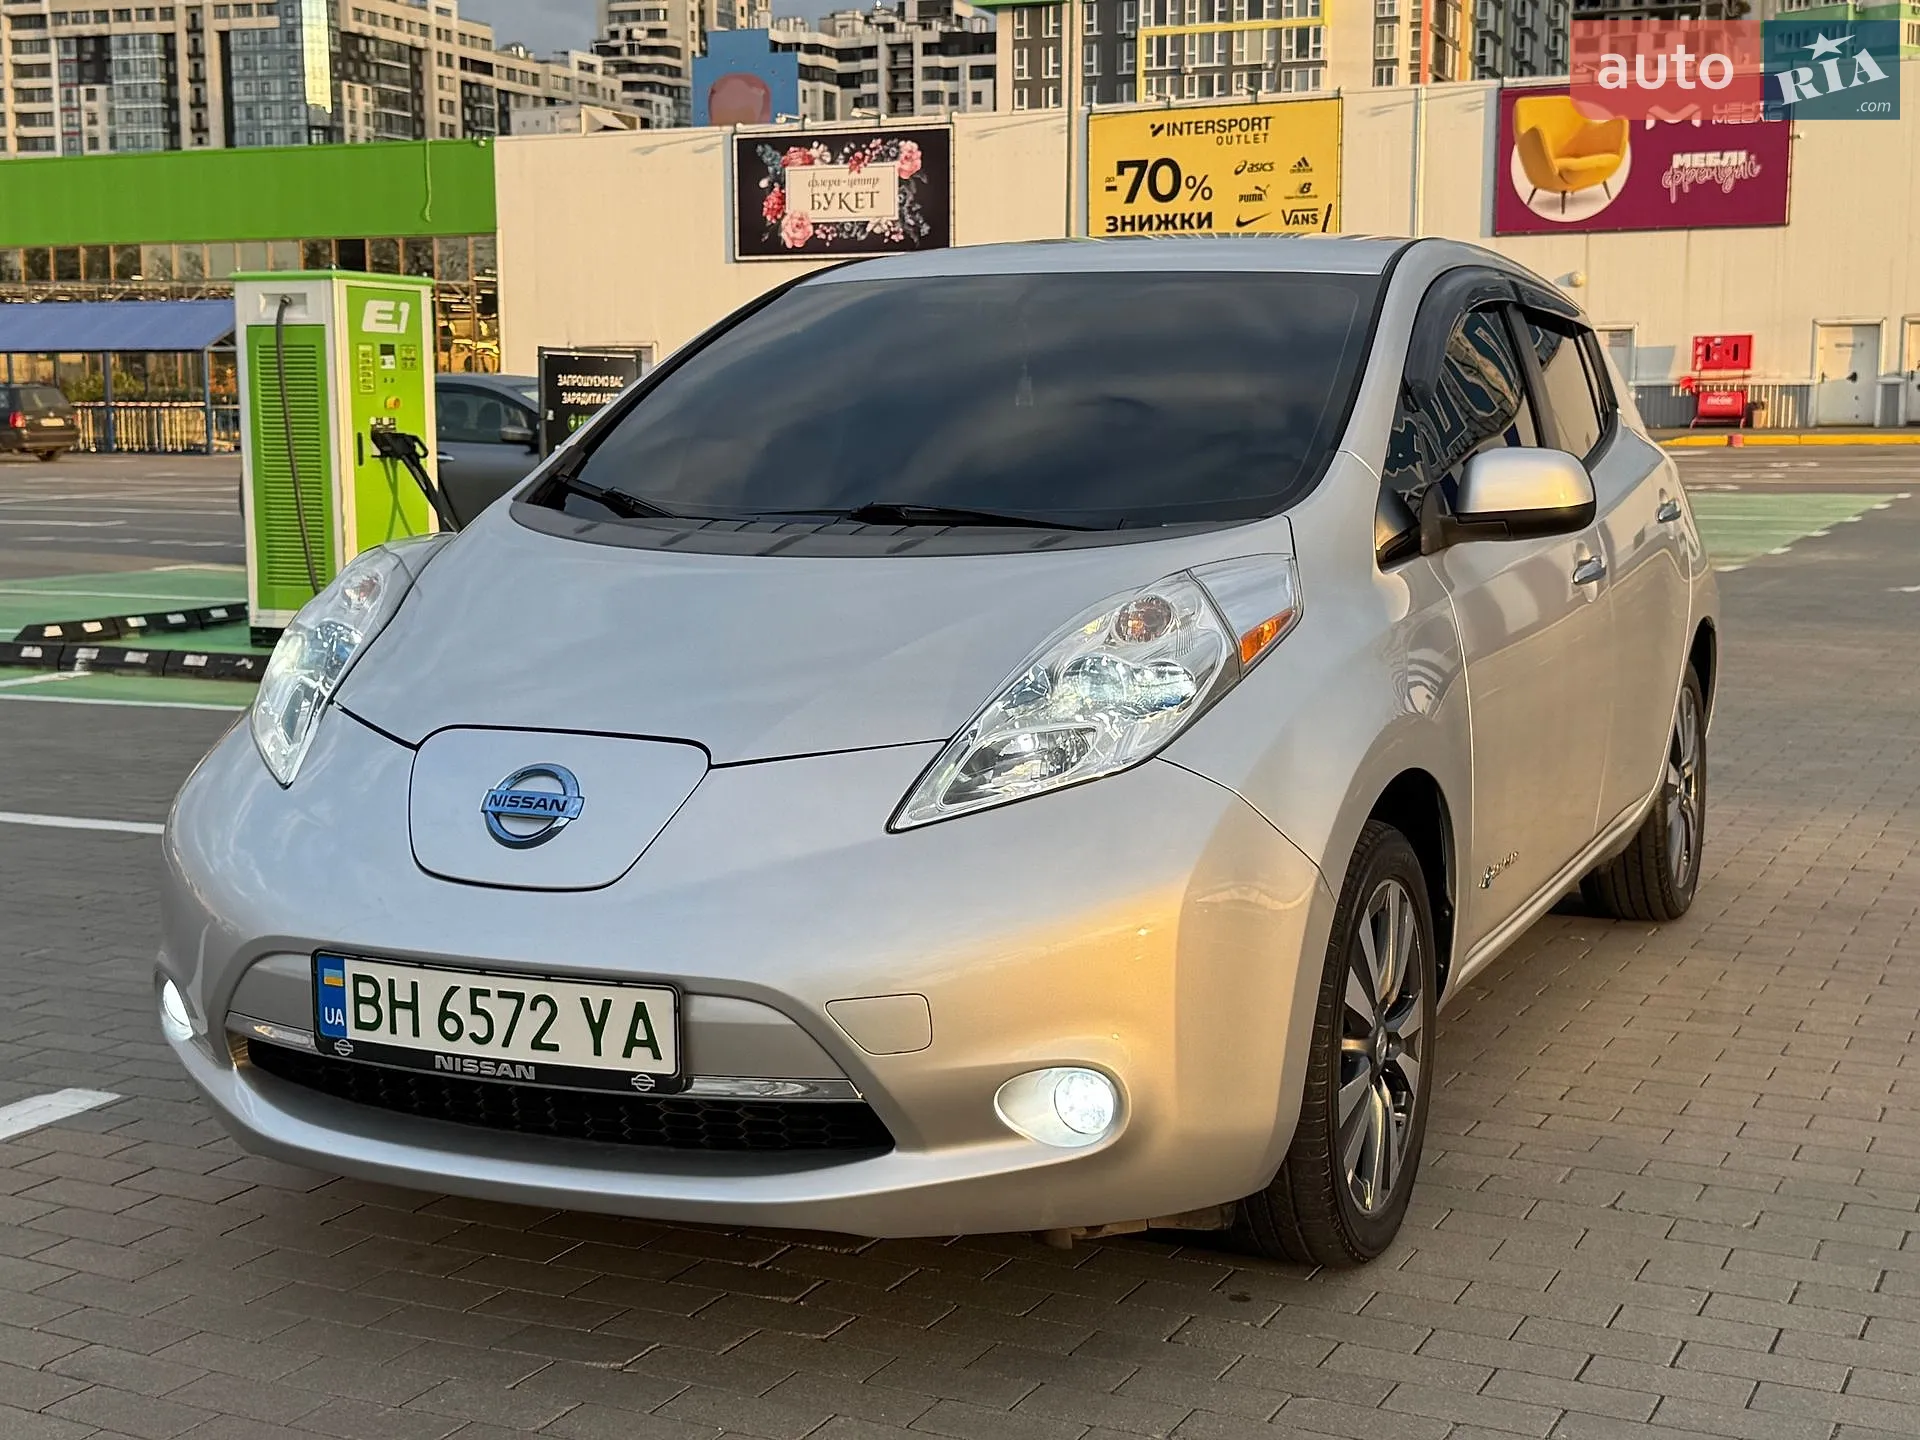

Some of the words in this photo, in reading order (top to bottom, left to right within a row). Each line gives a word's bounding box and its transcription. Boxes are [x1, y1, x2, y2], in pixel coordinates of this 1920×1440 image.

[1166, 116, 1272, 137] INTERSPORT
[1216, 133, 1269, 146] OUTLET
[811, 191, 880, 213] БУКЕТ
[1281, 208, 1318, 226] VANS
[362, 299, 410, 334] E1
[488, 794, 568, 813] NISSAN
[324, 1006, 345, 1027] UA
[351, 973, 420, 1038] BH
[437, 985, 560, 1053] 6572
[579, 996, 663, 1061] YA
[434, 1054, 536, 1081] NISSAN
